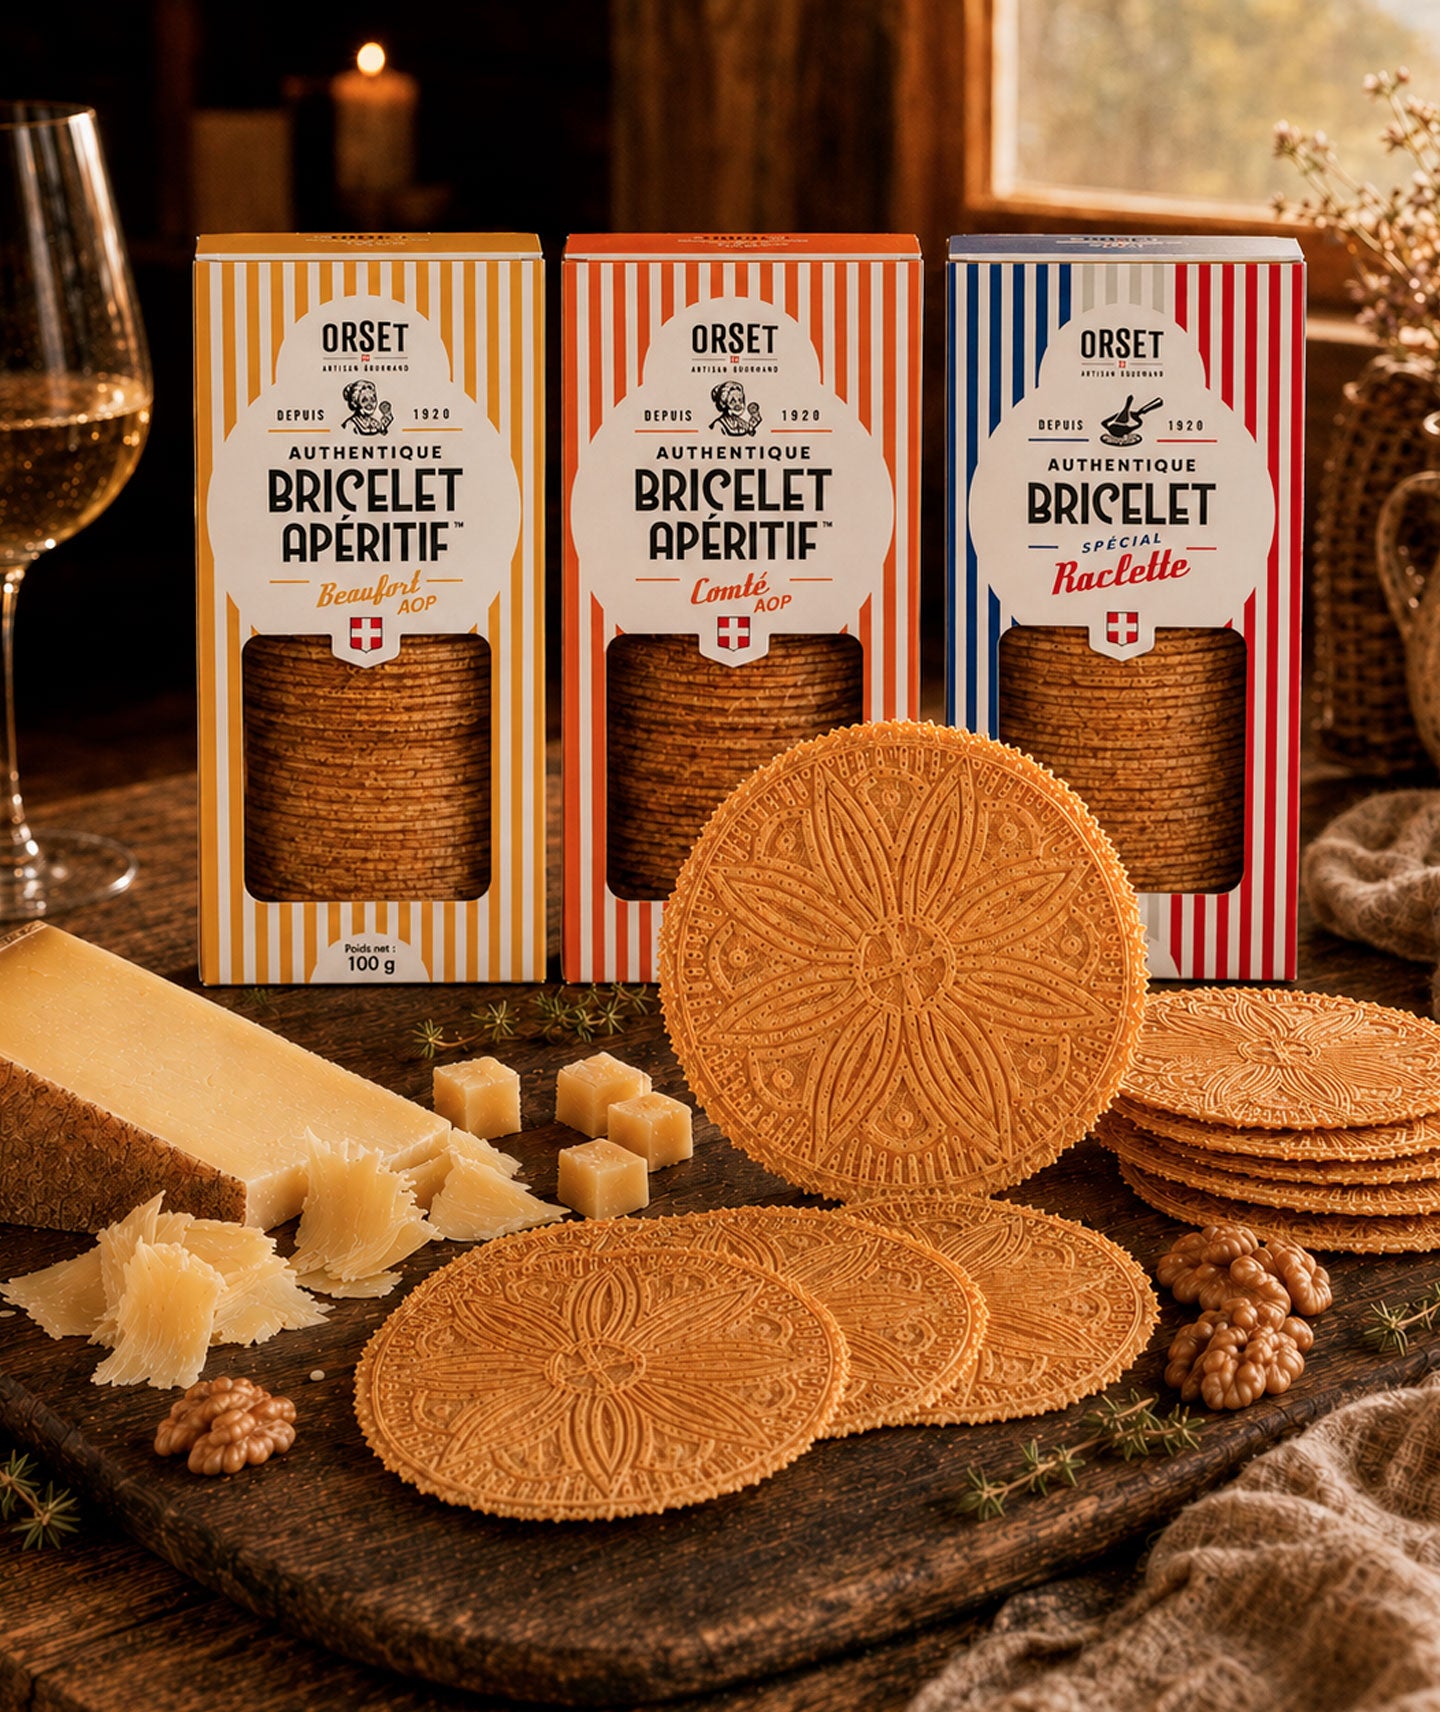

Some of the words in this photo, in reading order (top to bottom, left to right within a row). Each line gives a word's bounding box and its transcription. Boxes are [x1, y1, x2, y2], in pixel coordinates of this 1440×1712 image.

[323, 320, 409, 352] ORSET
[692, 322, 778, 354] ORSET
[1081, 328, 1164, 358] ORSET
[277, 409, 324, 421] DEPUIS
[413, 408, 450, 420] 1920
[644, 410, 693, 421] DEPUIS
[782, 410, 820, 421] 1920
[1039, 419, 1083, 430] DEPUIS
[1168, 420, 1204, 431] 1920
[289, 446, 442, 460] AUTHENTIQUE
[656, 446, 811, 461] AUTHENTIQUE
[1048, 458, 1196, 473] AUTHENTIQUE
[268, 468, 463, 513] BRICELET
[634, 468, 832, 512] BRICELET
[1028, 482, 1216, 525] BRICELET
[283, 515, 449, 562] APÉRITIF
[649, 513, 818, 560] APÉRITIF
[1081, 532, 1161, 553] SPÉCIAL
[1052, 548, 1190, 595] Raclette
[317, 569, 422, 608] Beaufort
[690, 572, 770, 605] Comté
[398, 596, 437, 615] AOP
[754, 595, 792, 613] AOP
[345, 942, 372, 953] Poids
[374, 944, 390, 953] net
[347, 955, 379, 972] 100
[384, 959, 395, 975] g
